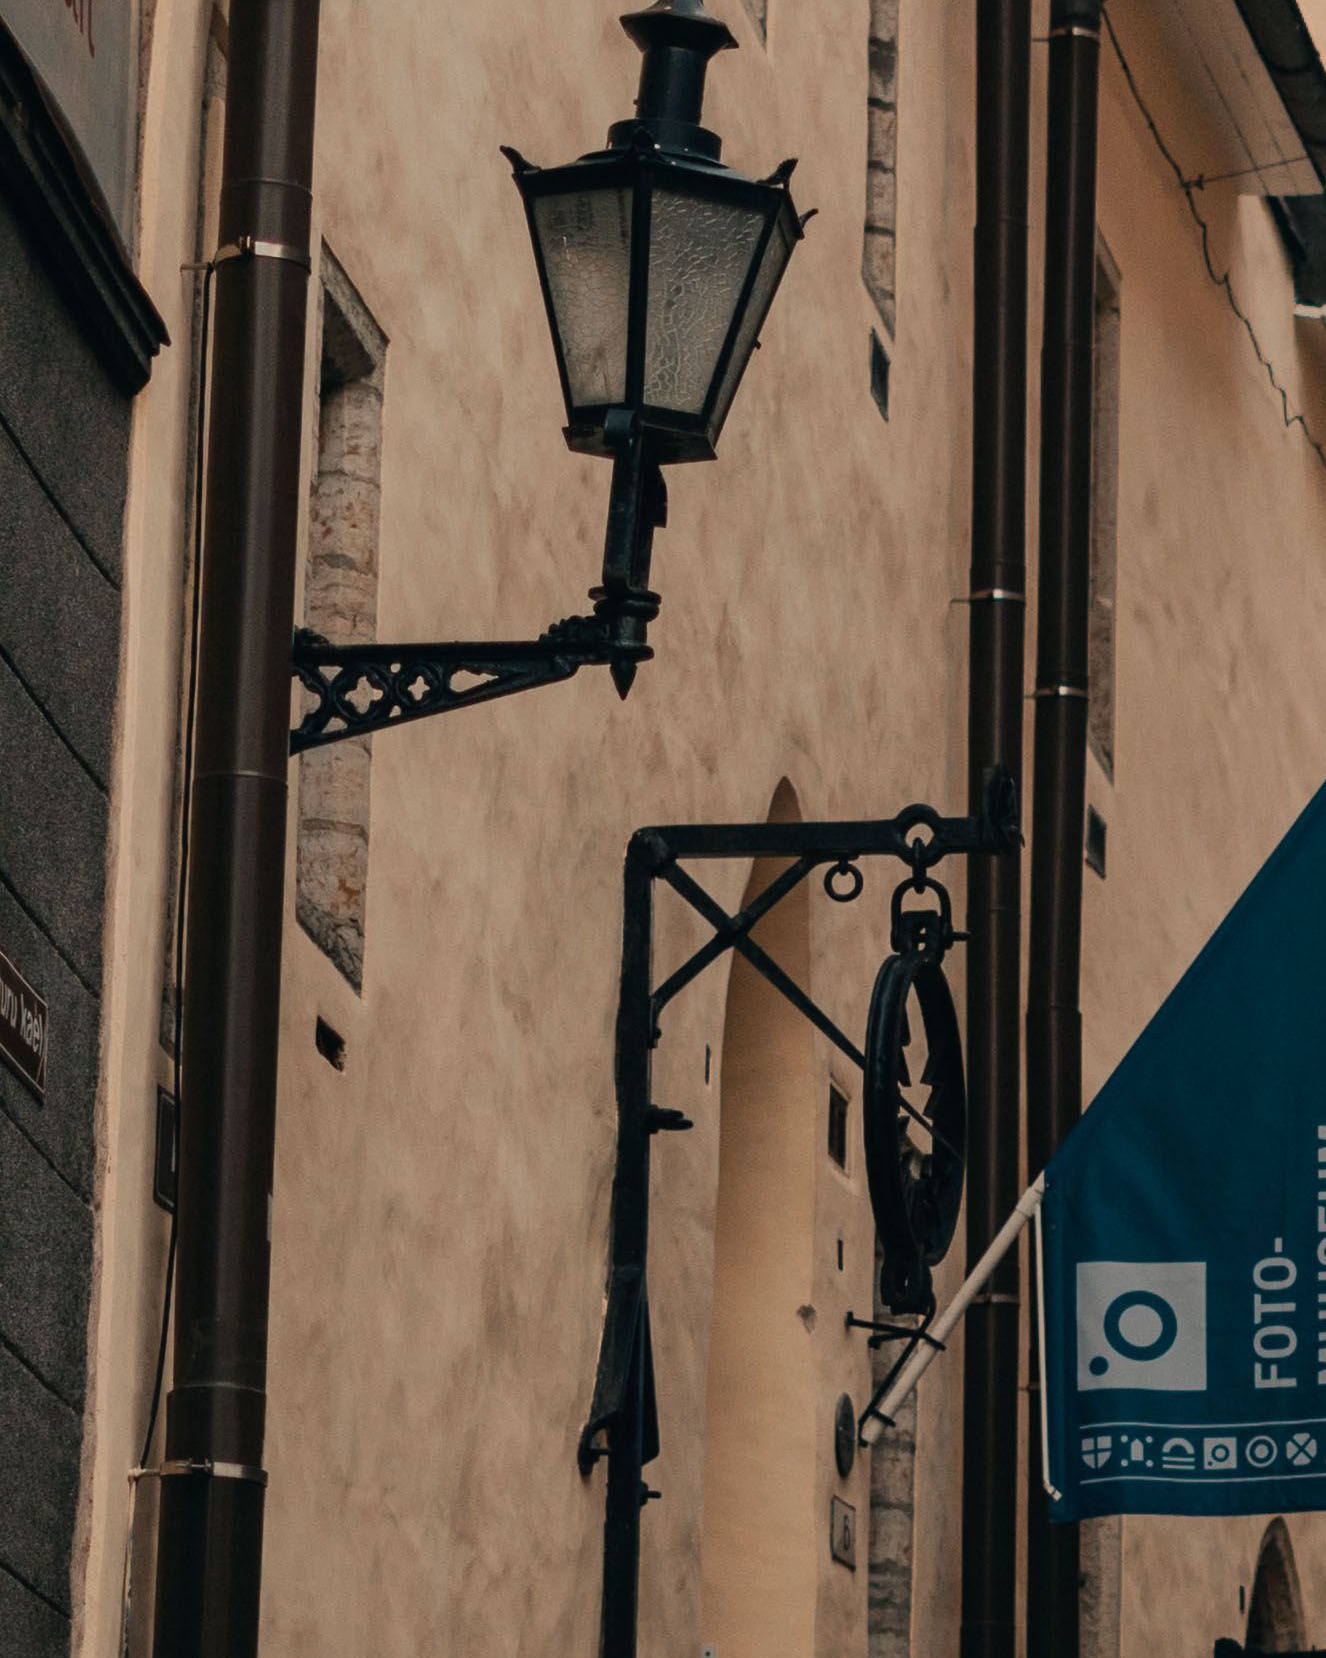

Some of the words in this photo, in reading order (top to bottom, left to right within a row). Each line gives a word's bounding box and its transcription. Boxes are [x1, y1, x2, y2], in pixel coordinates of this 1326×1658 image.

[0, 977, 18, 1029] uru
[20, 993, 43, 1056] kael
[1253, 1237, 1298, 1389] FOTO-
